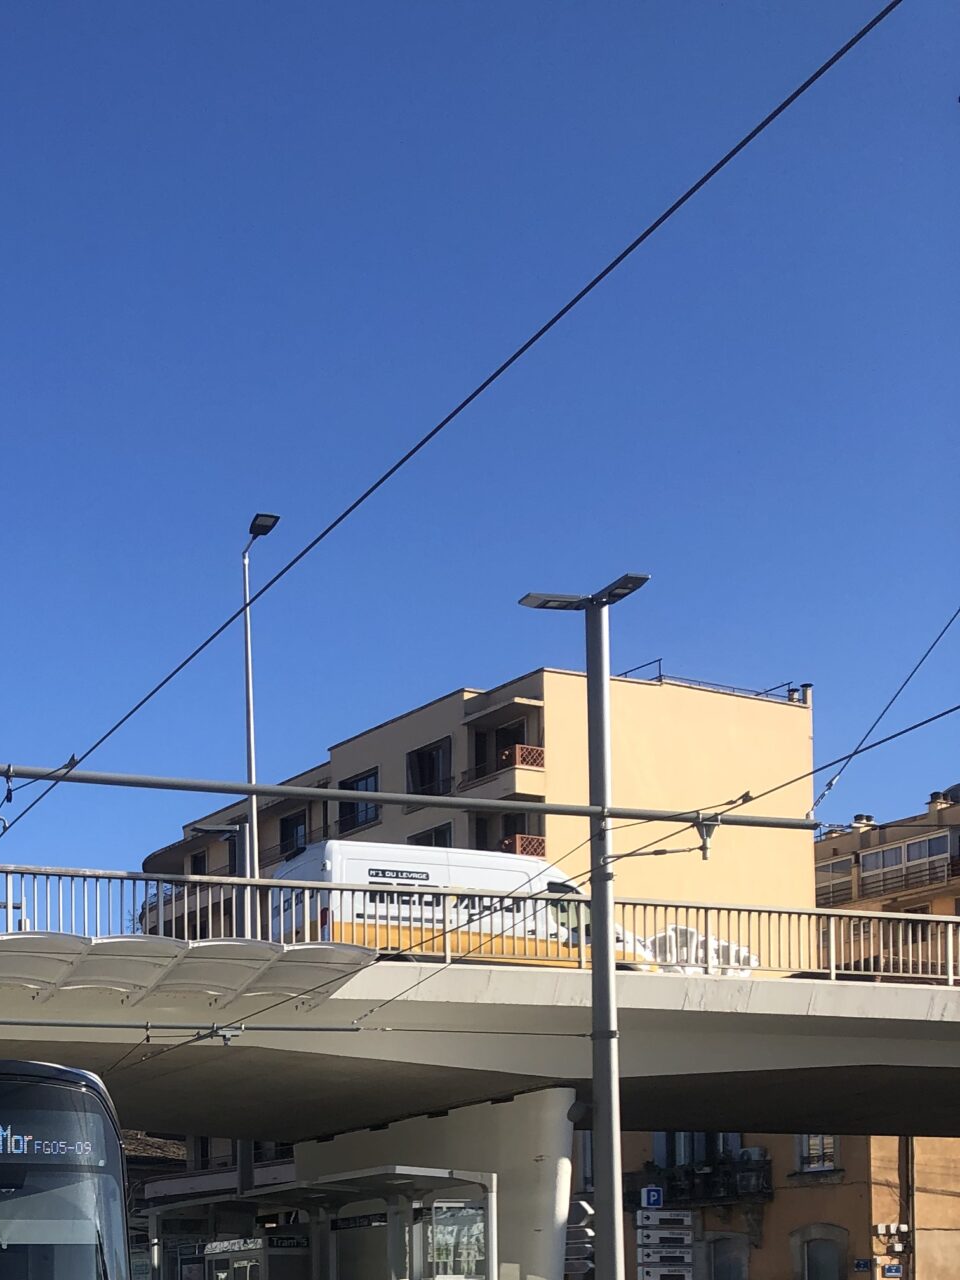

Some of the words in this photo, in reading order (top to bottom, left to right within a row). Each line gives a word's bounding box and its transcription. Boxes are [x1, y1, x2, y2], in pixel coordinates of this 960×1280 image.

[398, 872, 428, 880] LEVAGE
[35, 1141, 92, 1155] FG05-09
[271, 1237, 297, 1247] Tram
